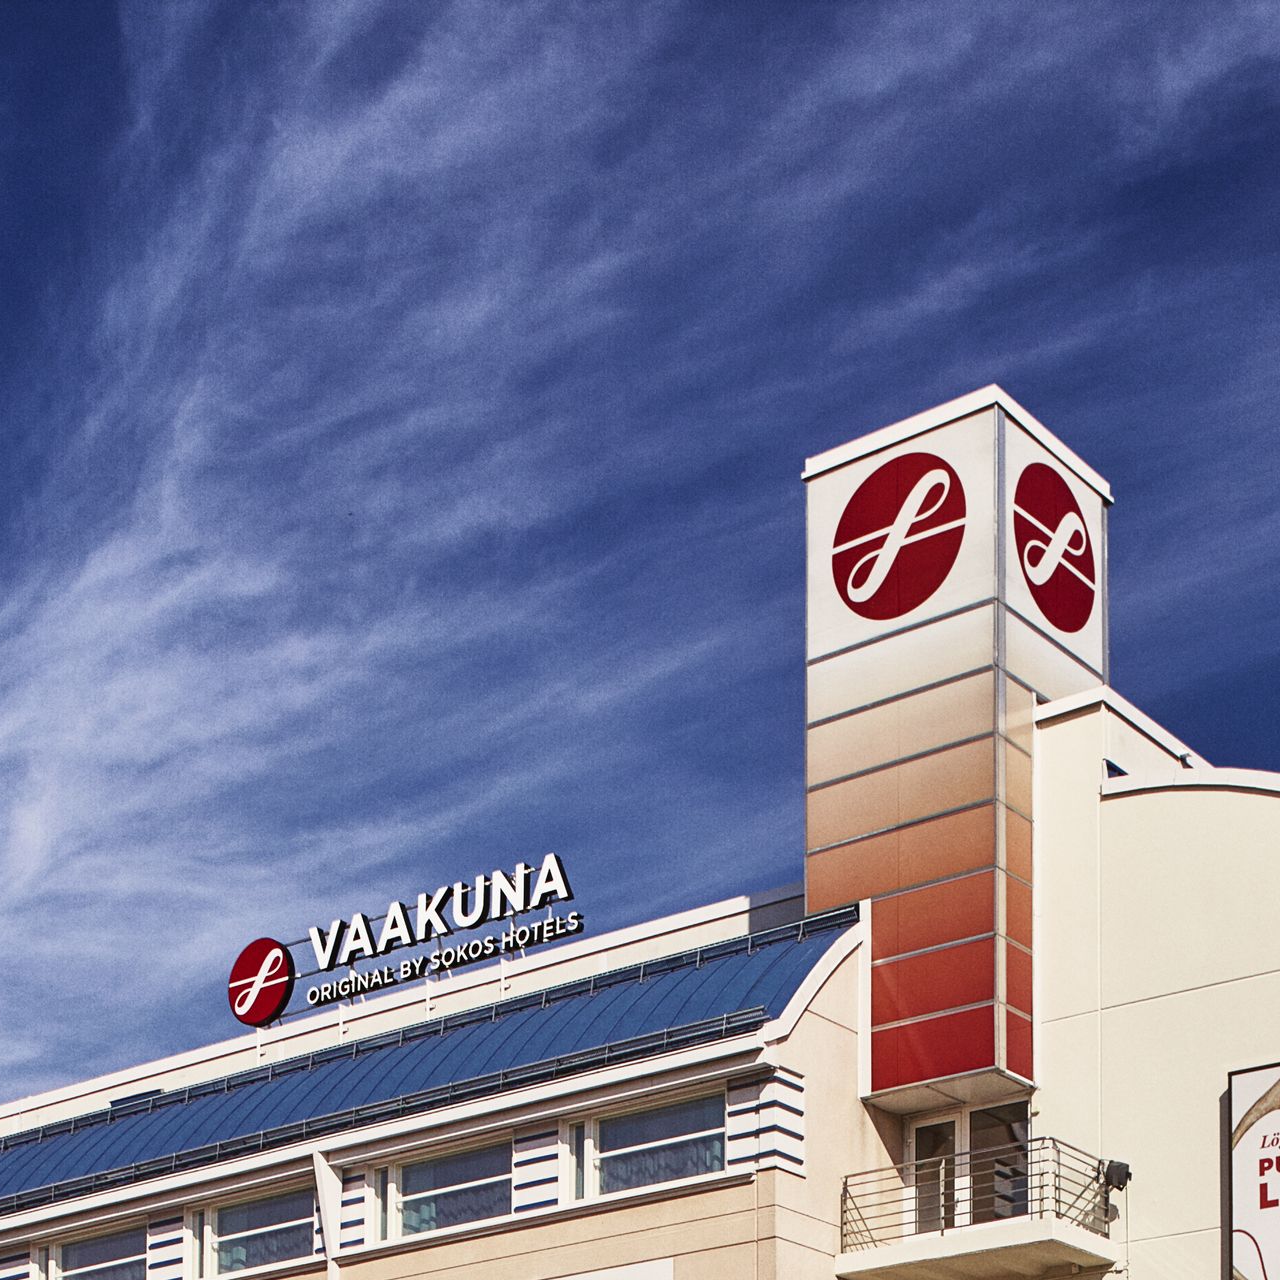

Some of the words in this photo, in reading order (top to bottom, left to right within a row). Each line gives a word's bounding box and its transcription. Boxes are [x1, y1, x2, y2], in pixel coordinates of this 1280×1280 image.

[306, 971, 394, 1006] ORIGINAL
[400, 955, 429, 980] BY
[429, 935, 497, 971] SOKOS
[500, 911, 582, 951] HOTELS
[308, 852, 573, 971] VAAKUNA
